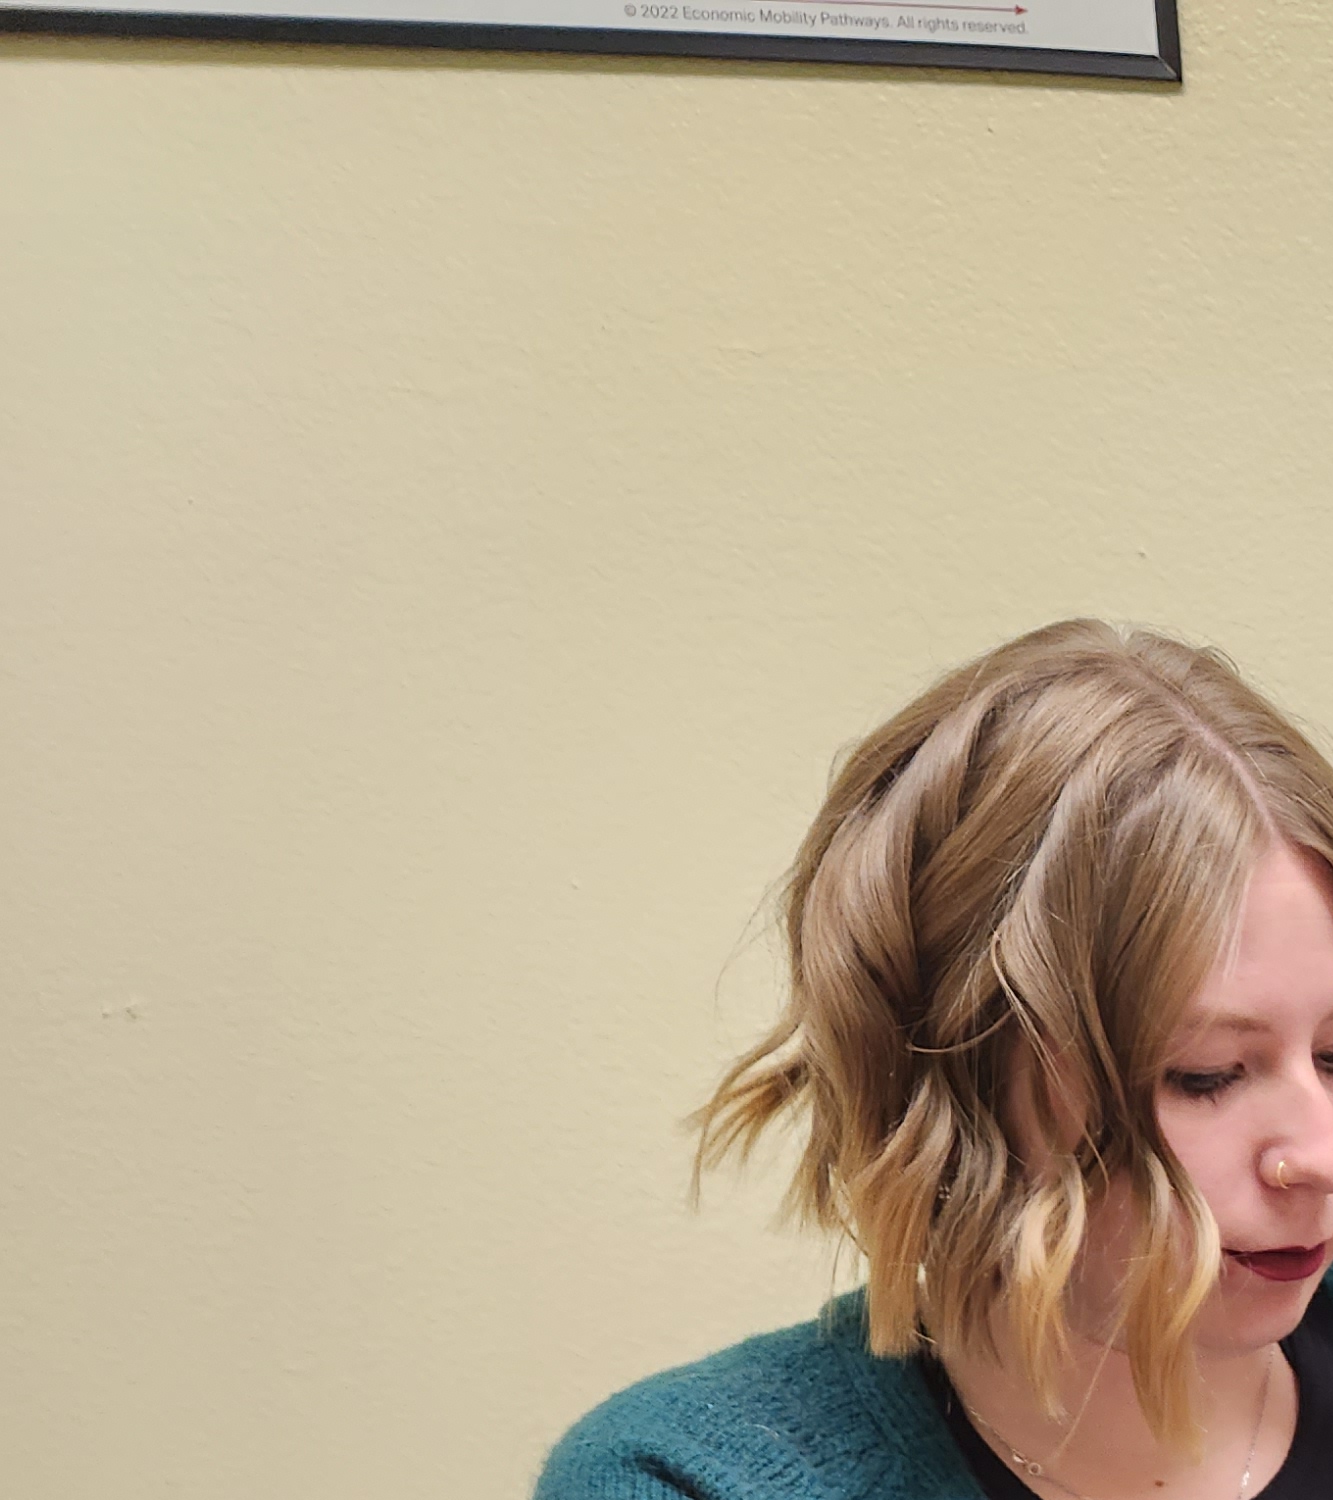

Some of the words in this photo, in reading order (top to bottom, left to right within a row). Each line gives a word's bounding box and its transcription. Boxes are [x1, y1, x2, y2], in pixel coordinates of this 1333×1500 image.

[641, 4, 679, 20] 2022
[682, 6, 756, 24] Economic
[759, 9, 816, 28] Mobility
[820, 12, 894, 31] Pathways.
[897, 15, 915, 30] All
[917, 17, 960, 34] rights
[962, 21, 1029, 35] reserved.
